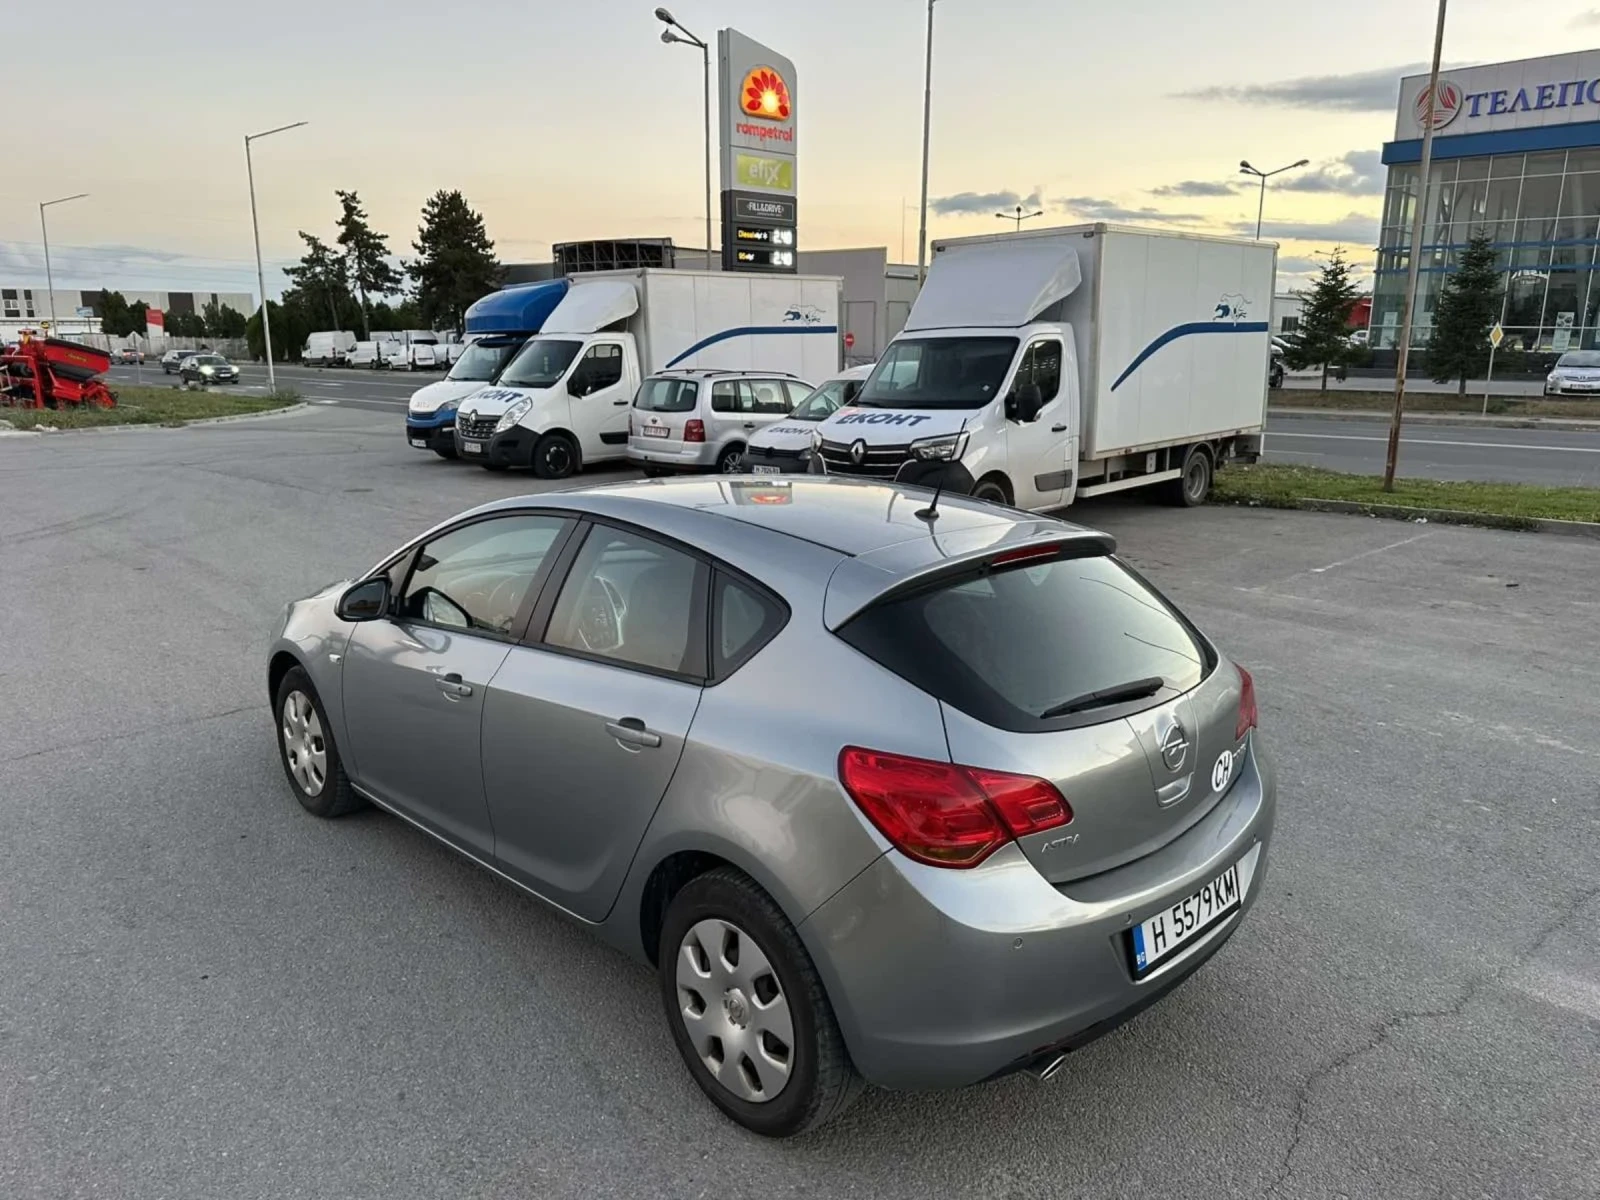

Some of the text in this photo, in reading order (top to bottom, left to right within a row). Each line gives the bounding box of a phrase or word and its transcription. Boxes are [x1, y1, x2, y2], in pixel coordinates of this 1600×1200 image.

[736, 122, 793, 142] rompetrol
[836, 413, 931, 427] ЕКОНТ
[1215, 753, 1231, 788] CH
